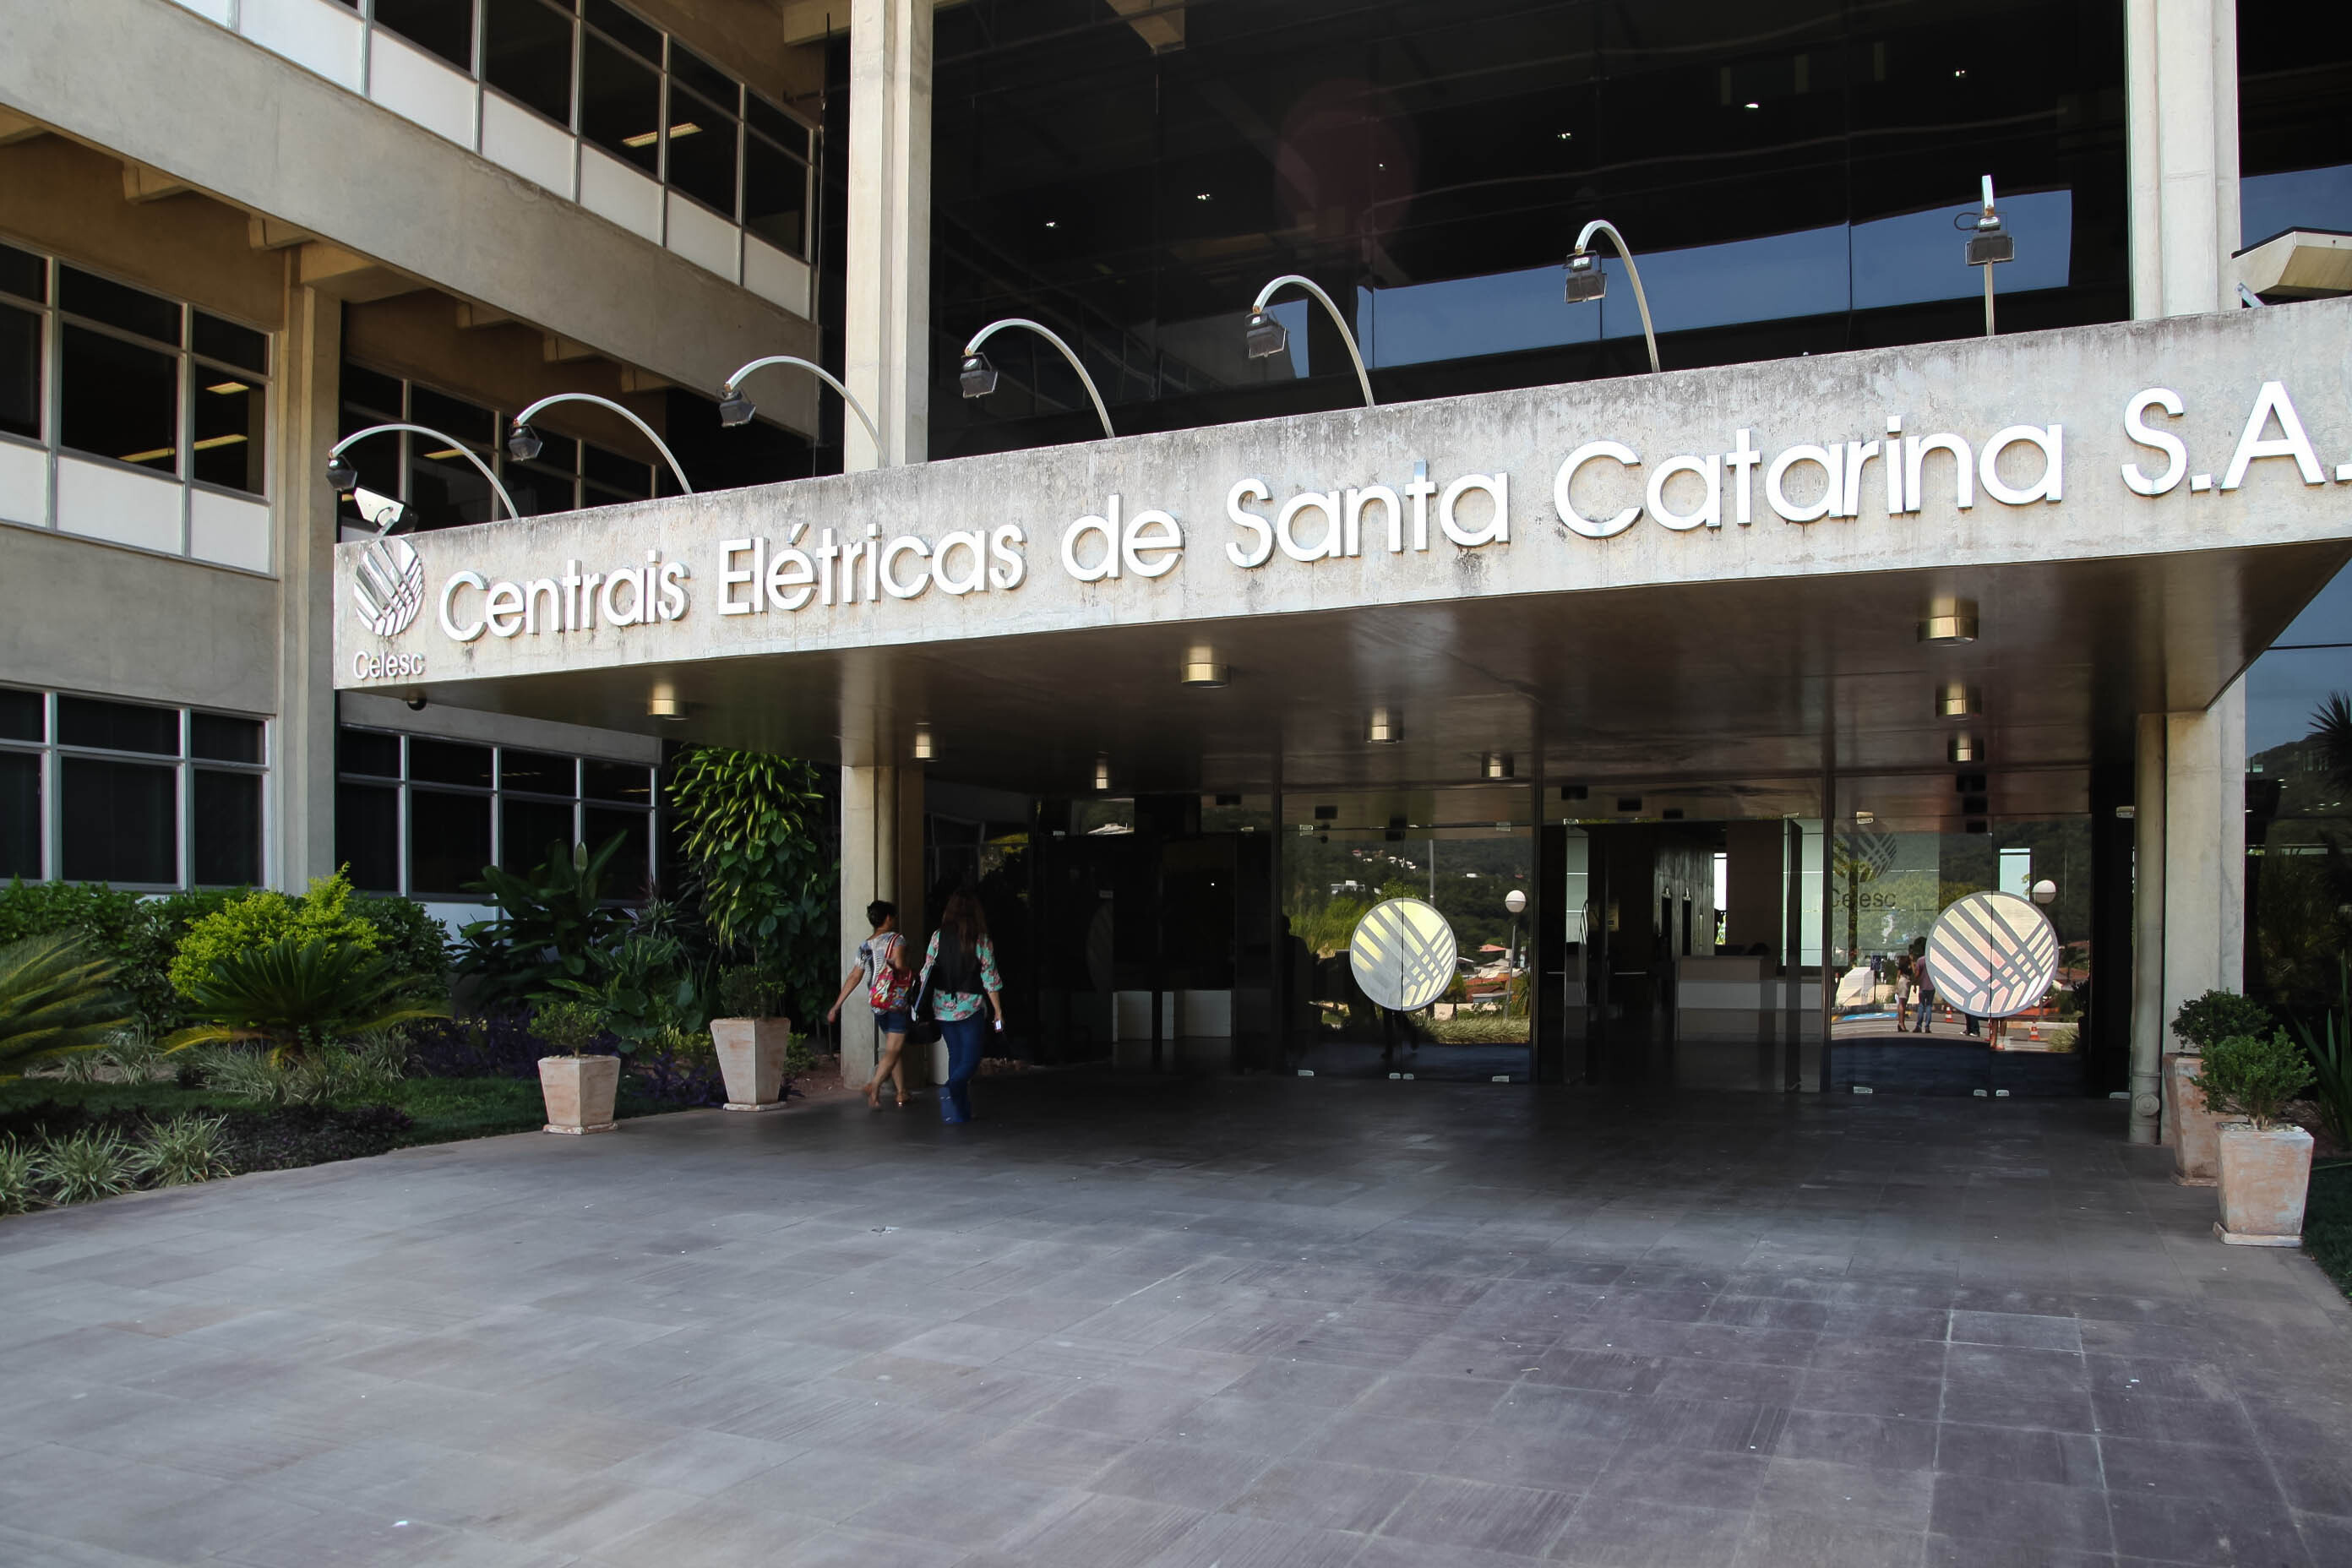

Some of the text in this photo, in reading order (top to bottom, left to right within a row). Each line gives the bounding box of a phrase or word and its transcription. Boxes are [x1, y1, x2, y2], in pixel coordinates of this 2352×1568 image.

[438, 381, 2352, 642] Centrais Elétricas de Santa Catarina S.A.
[353, 650, 426, 680] Celesc
